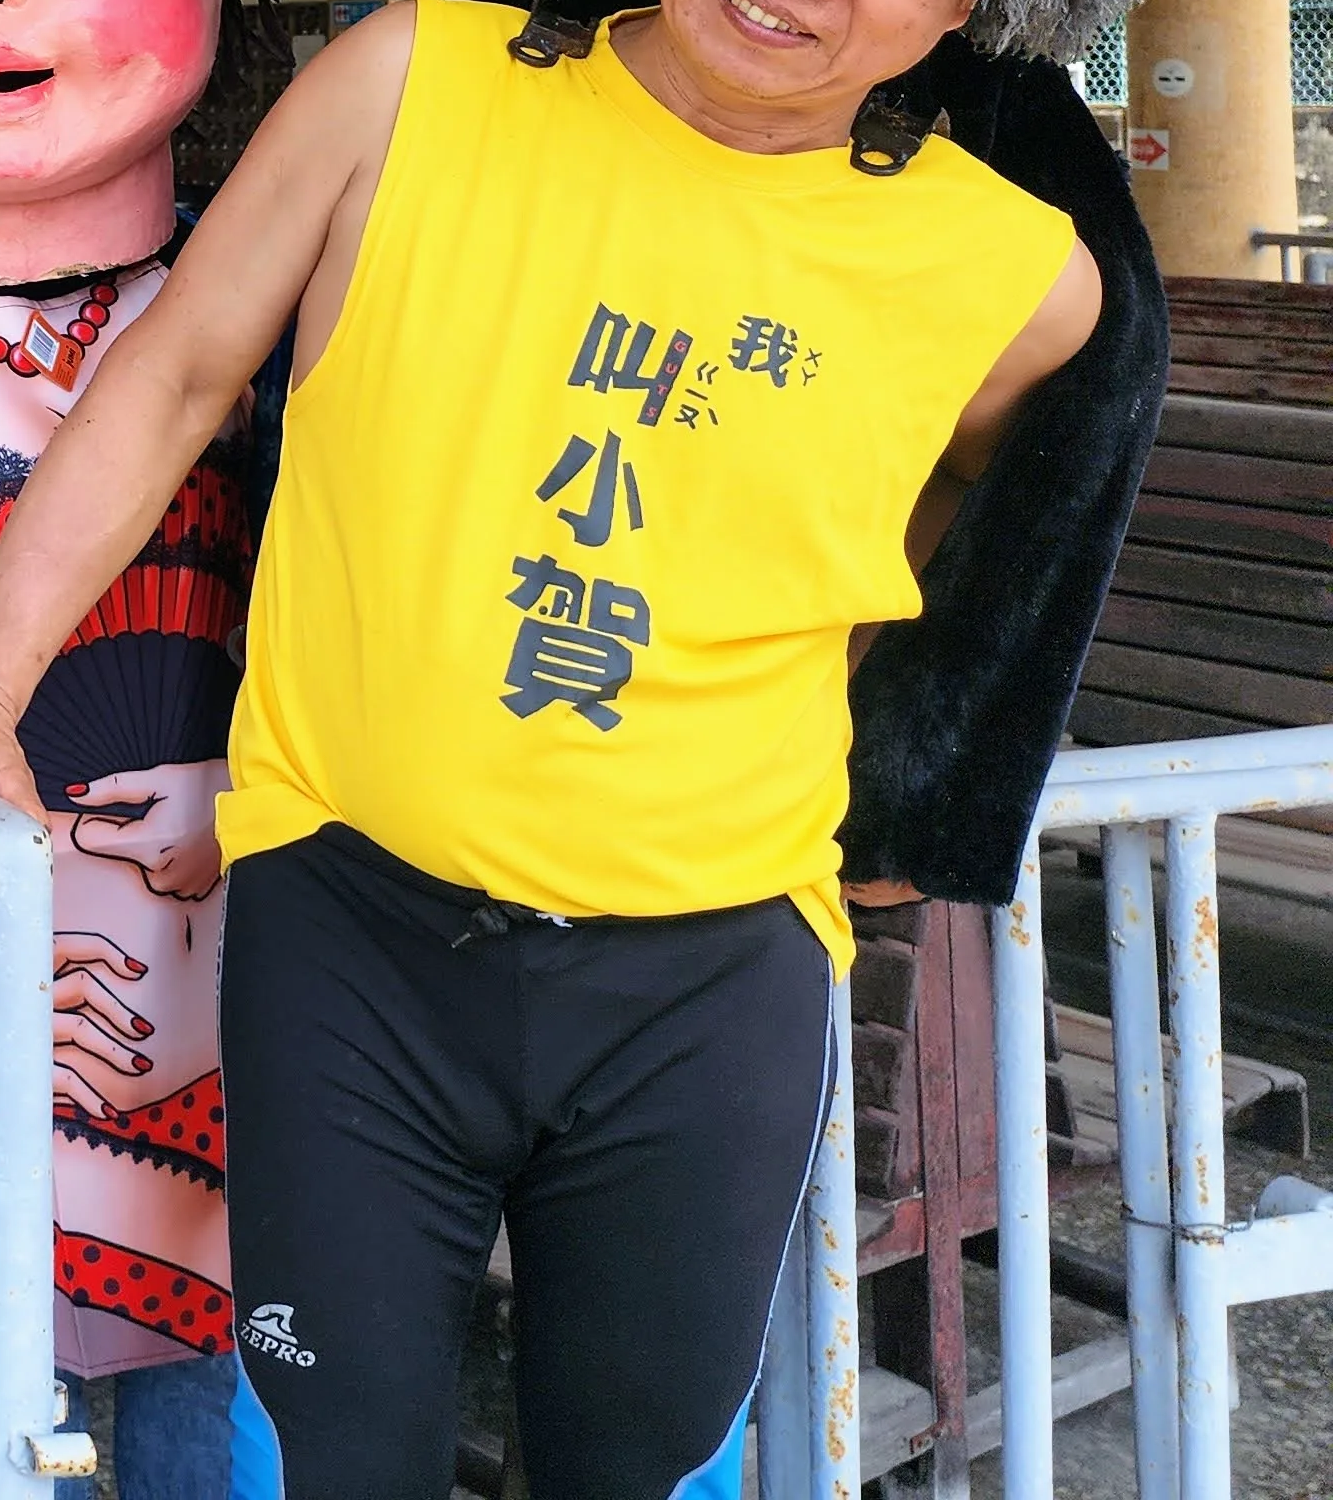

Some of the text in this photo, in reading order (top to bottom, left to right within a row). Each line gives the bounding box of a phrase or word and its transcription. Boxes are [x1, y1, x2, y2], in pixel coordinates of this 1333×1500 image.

[645, 339, 688, 419] GUTS
[728, 314, 798, 389] 我
[499, 301, 694, 732] 叫小賀
